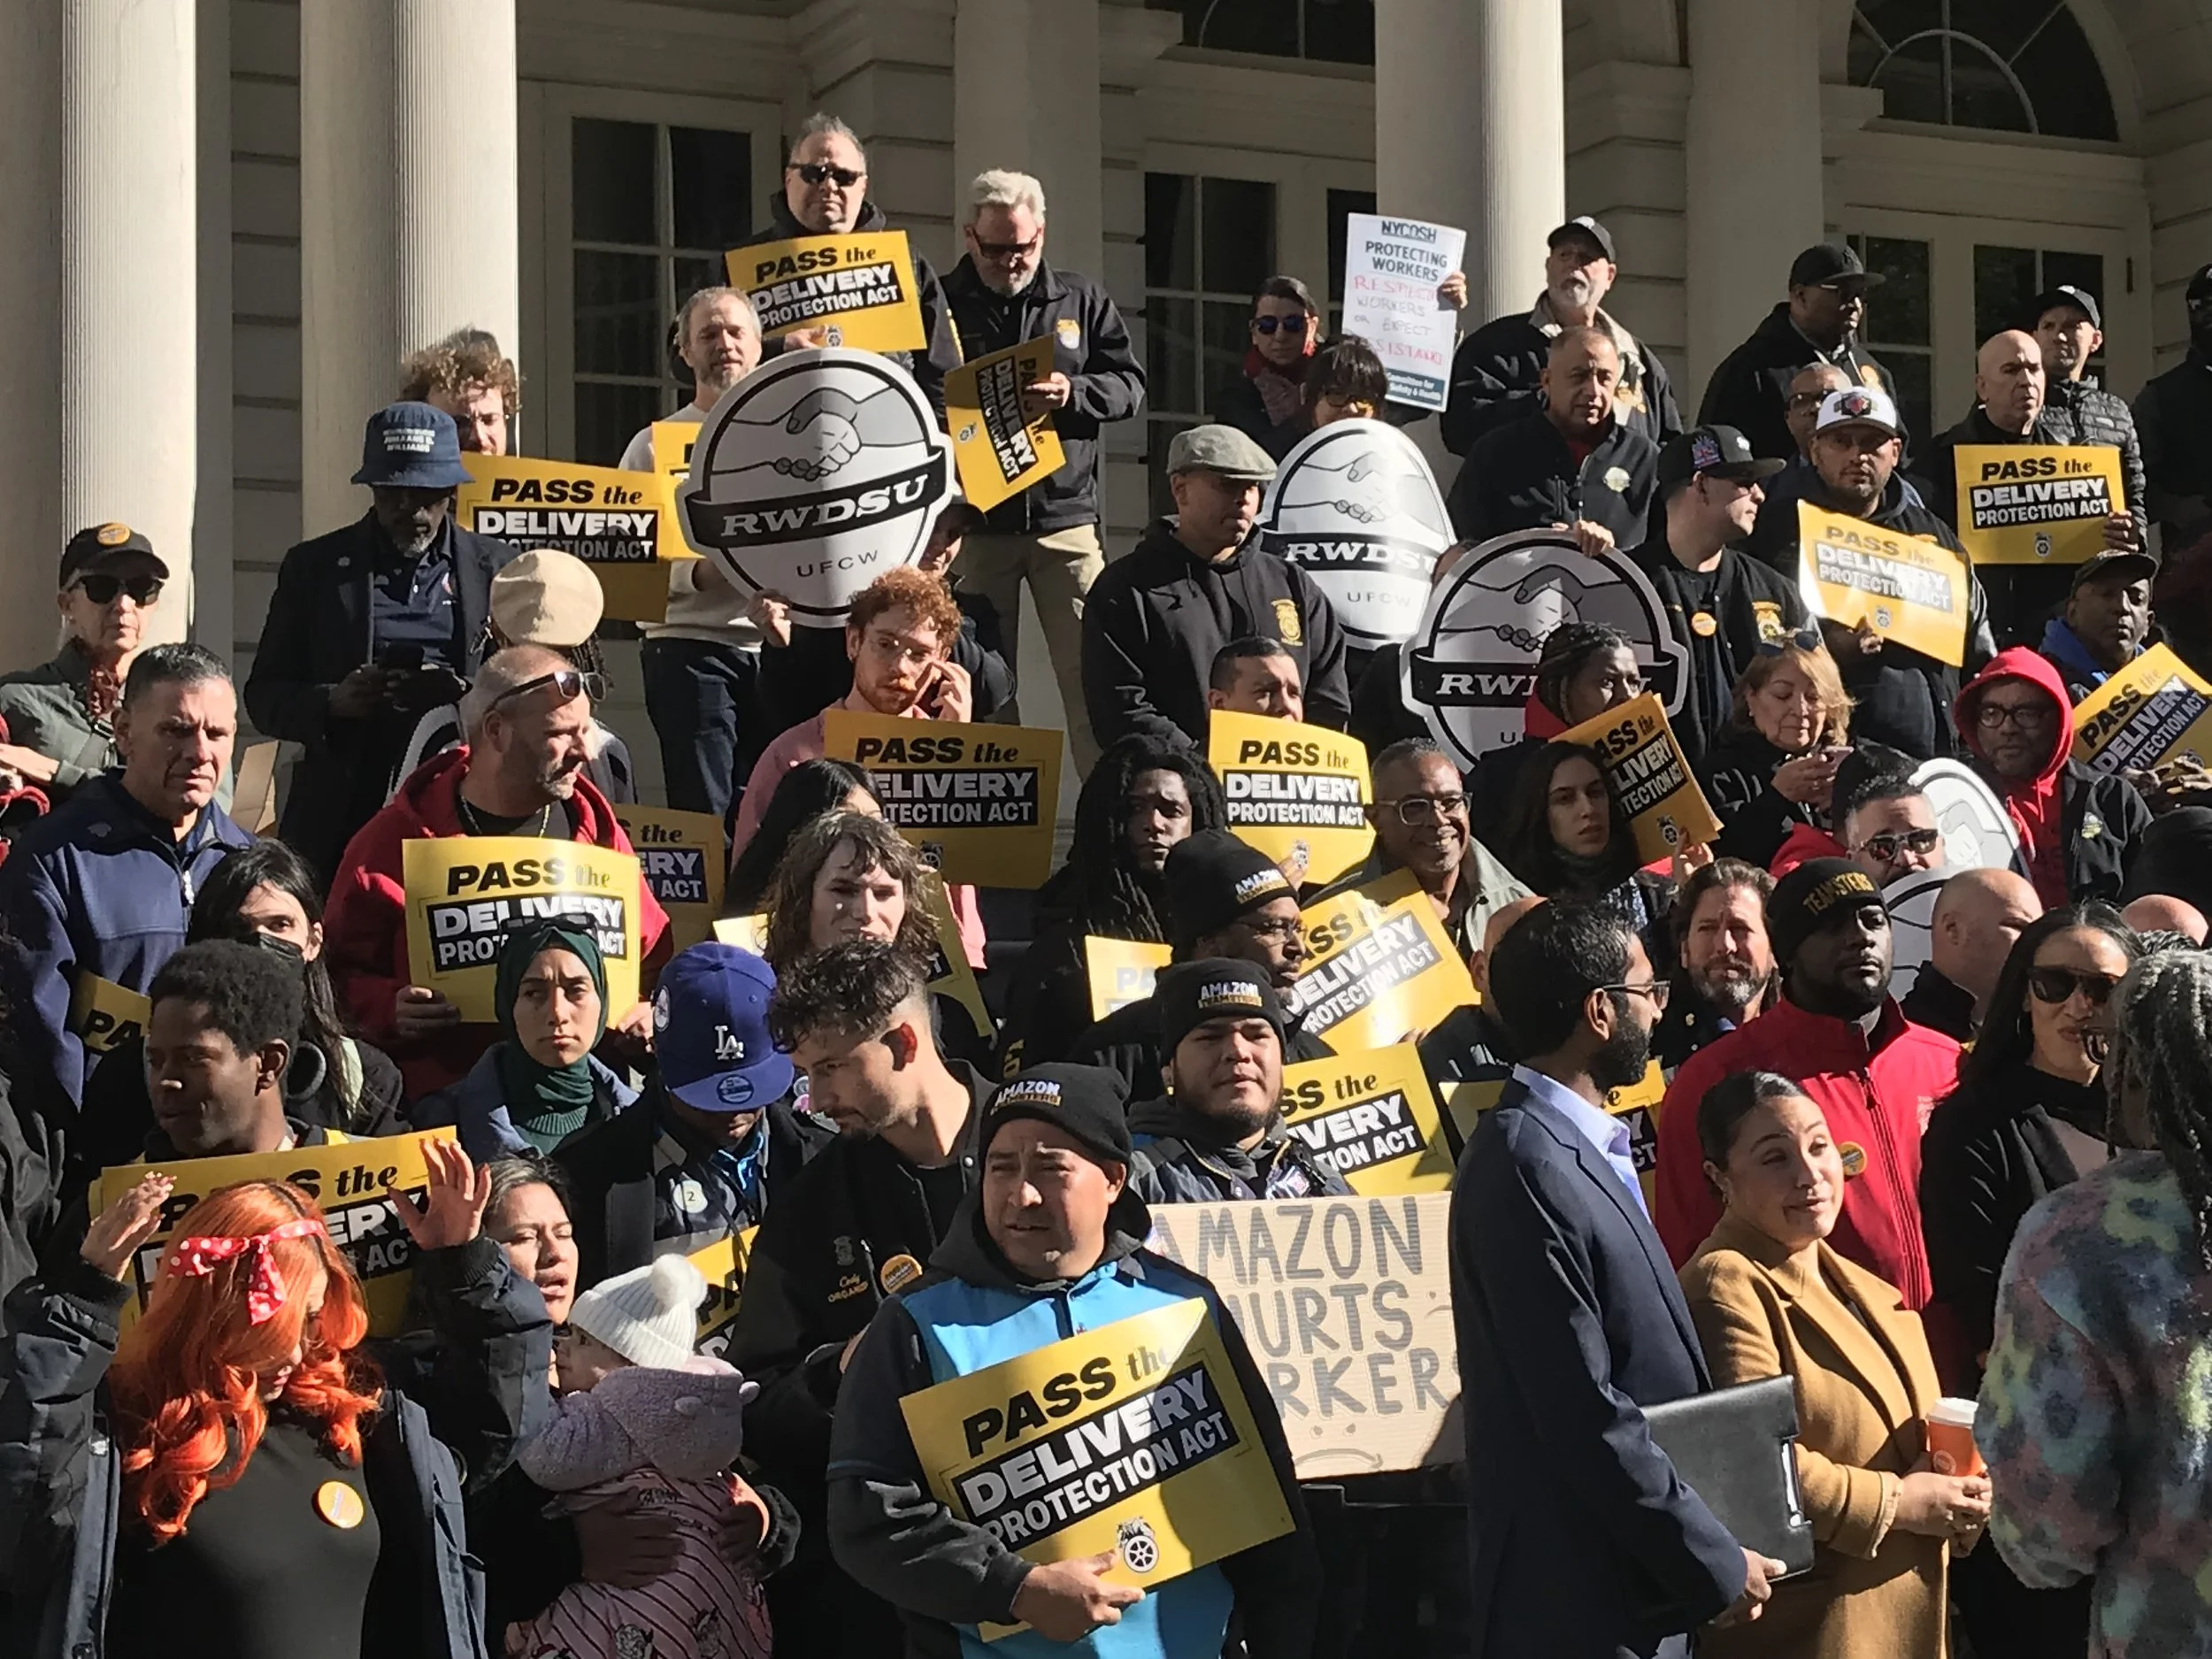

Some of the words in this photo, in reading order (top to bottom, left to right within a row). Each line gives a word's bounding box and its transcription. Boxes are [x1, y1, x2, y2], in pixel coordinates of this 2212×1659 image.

[756, 247, 838, 284] PASS
[846, 247, 876, 263] the
[1365, 241, 1448, 268] PROTECTING
[1372, 257, 1438, 281] WORKERS
[751, 264, 892, 311] DELIVERY
[760, 290, 864, 327] PROTECTION
[866, 284, 898, 305] ACT
[995, 357, 1036, 465] DELIVERY
[998, 447, 1021, 478] ACT
[1982, 457, 2056, 480] PASS
[2064, 458, 2093, 473] the
[491, 479, 595, 503] PASS
[603, 486, 642, 504] the
[720, 474, 928, 536] RWDSU
[1973, 478, 2104, 508] DELIVERY
[478, 511, 654, 536] DELIVERY
[1976, 501, 2076, 526] PROTECTION
[2079, 499, 2108, 515] ACT
[614, 540, 653, 558] ACT
[1825, 526, 1900, 557] PASS
[797, 549, 878, 577] UFCW
[1816, 542, 1947, 590] DELIVERY
[1919, 588, 1949, 608] ACT
[2079, 683, 2141, 749] PASS
[2093, 676, 2187, 773] DELIVERY
[2129, 710, 2189, 768] OTECTION
[2182, 692, 2207, 717] ACT
[855, 737, 964, 764] PASS
[973, 742, 1018, 763] the
[1239, 740, 1320, 766] PASS
[1326, 749, 1349, 769] the
[1594, 719, 1640, 761] ASS
[1611, 734, 1673, 793] LIVERY
[878, 772, 1033, 798] ELIVERY
[1226, 772, 1360, 803] DELIVERY
[1618, 770, 1673, 814] TECTION
[886, 803, 985, 823] TECTION
[987, 802, 1033, 822] ACT
[1227, 803, 1336, 824] PROTECTION
[1338, 805, 1364, 826] ACT
[641, 824, 682, 843] the
[447, 857, 565, 895] PASS
[575, 864, 610, 888] the
[661, 879, 702, 898] ACT
[1398, 941, 1434, 975] ACT
[714, 1025, 744, 1060] LA
[995, 1080, 1061, 1107] AMAZON
[1334, 1074, 1379, 1100] the
[1371, 1125, 1417, 1159] ACT
[335, 1164, 397, 1197] the
[688, 1192, 695, 1202] 2
[367, 1240, 412, 1271] AC
[1152, 1196, 1423, 1286] AMAZON
[1267, 1348, 1458, 1419] RKER
[963, 1356, 1116, 1459] PASS
[961, 1369, 1209, 1517] DELIVERY
[984, 1438, 1178, 1546] PROTECTION
[1179, 1412, 1230, 1461] ACT
